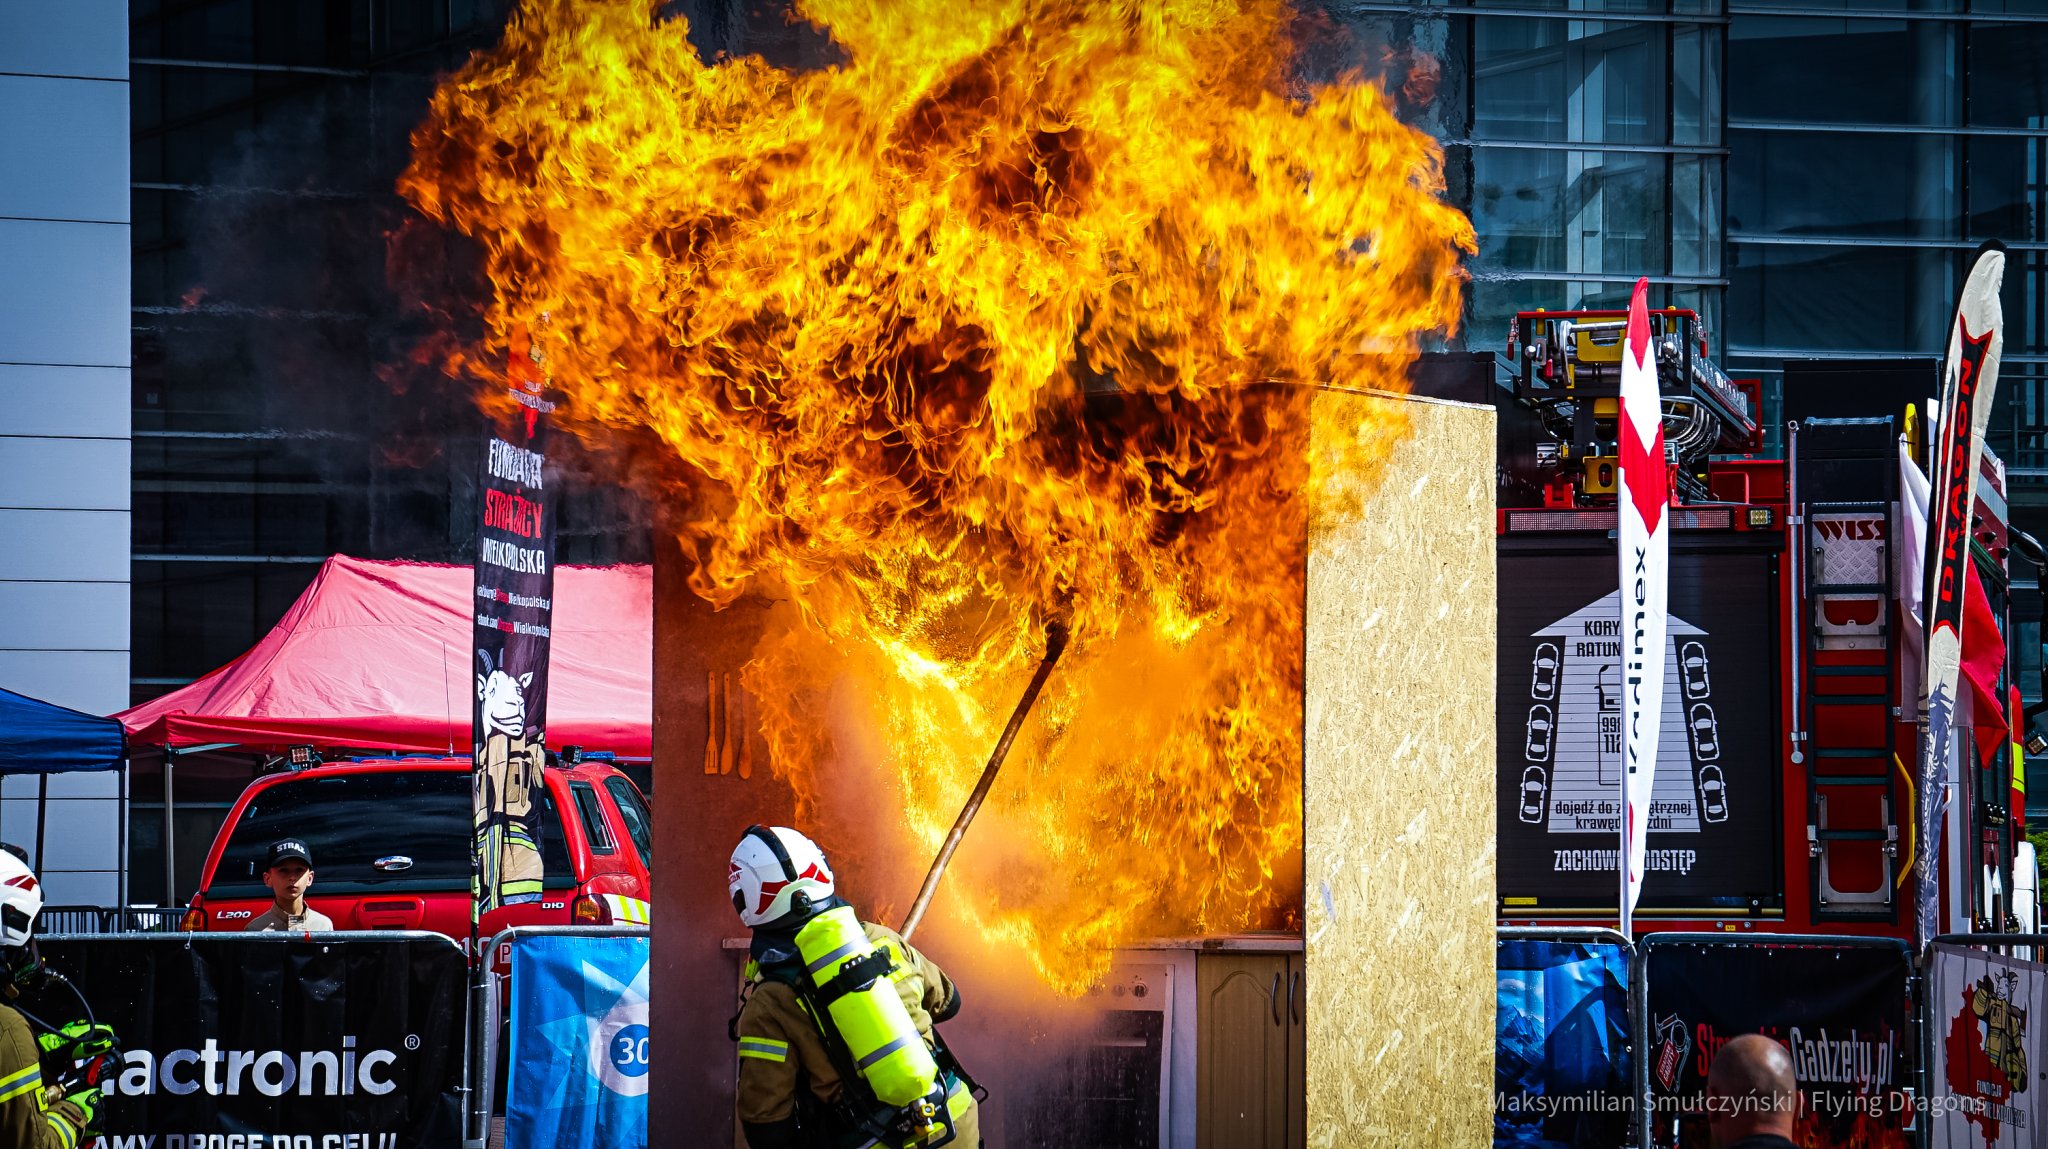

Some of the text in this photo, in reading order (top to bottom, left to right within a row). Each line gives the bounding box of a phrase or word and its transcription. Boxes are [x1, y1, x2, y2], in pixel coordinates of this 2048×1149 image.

[1584, 620, 1620, 636] KORY
[1576, 642, 1620, 657] RATUN
[1555, 800, 1595, 816] dojedź
[1598, 801, 1612, 814] do
[1575, 816, 1672, 832] krawęd zdni
[1553, 849, 1621, 871] ZACHOW
[216, 911, 252, 919] L200
[101, 1035, 398, 1097] actronic
